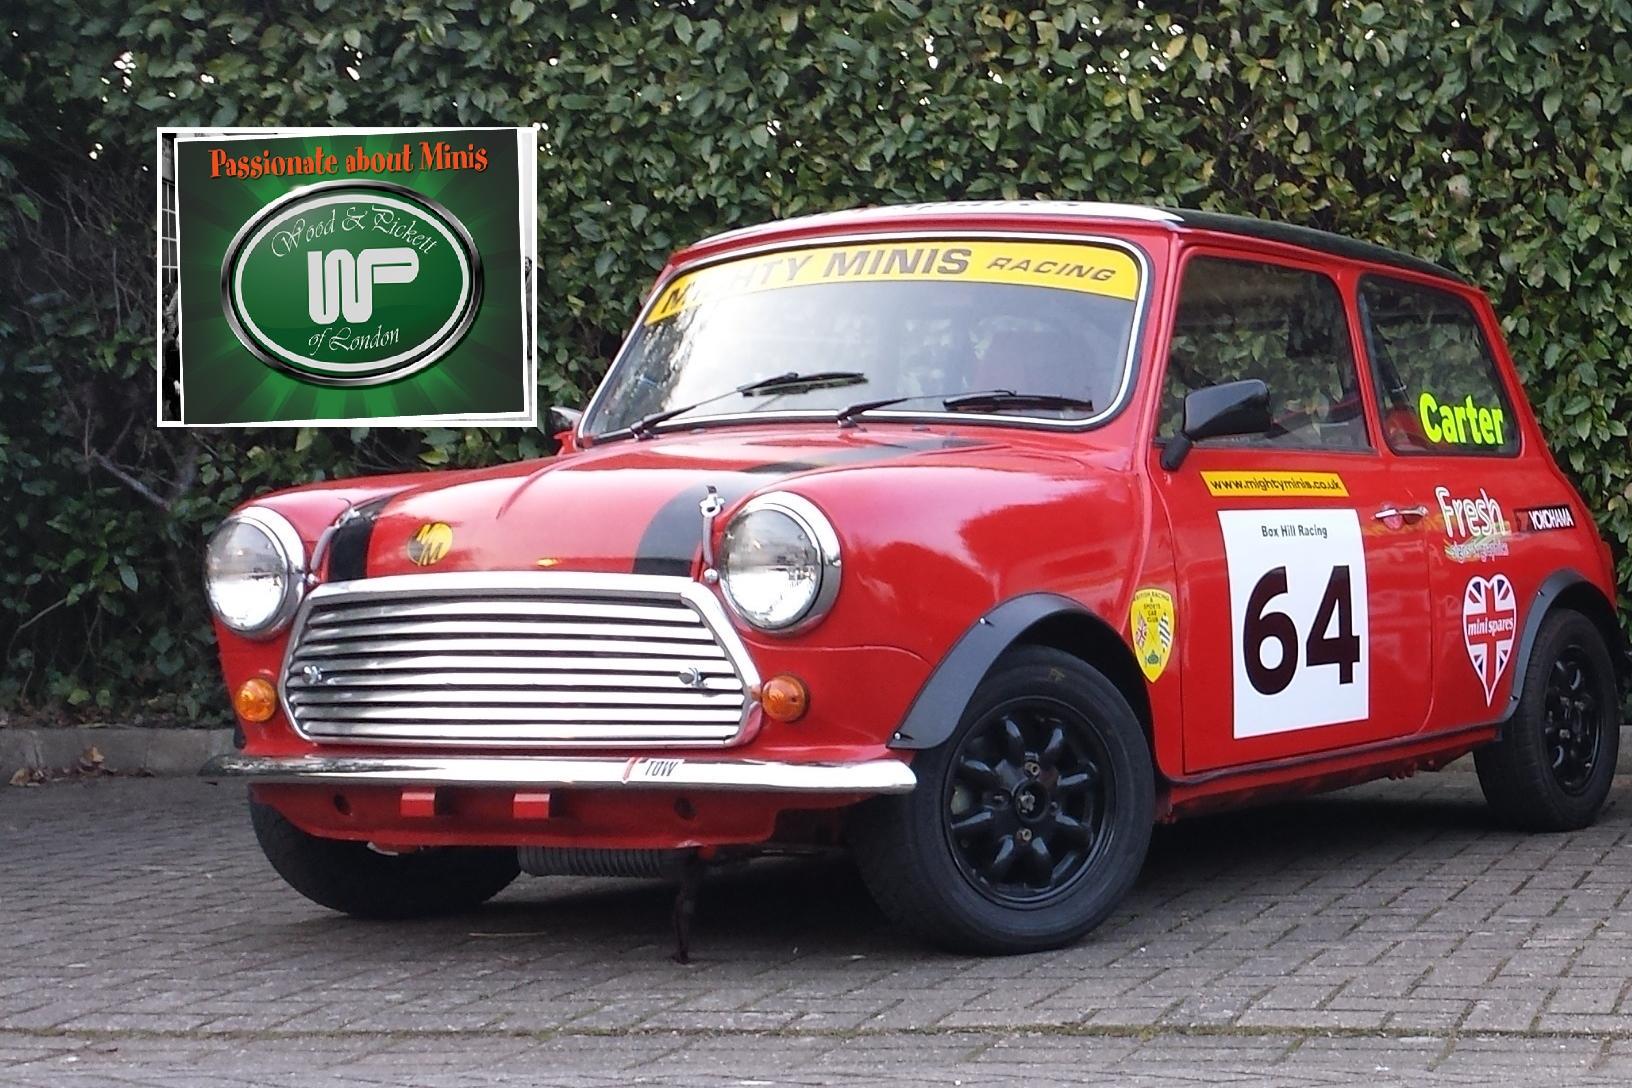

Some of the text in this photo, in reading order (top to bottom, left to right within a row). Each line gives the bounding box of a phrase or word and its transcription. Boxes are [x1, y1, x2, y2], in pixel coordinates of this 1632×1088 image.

[823, 248, 971, 278] MINIS
[985, 257, 1116, 281] RACING
[1419, 392, 1504, 445] Carter
[1211, 477, 1341, 492] www.mightyminis.co.uk
[1434, 486, 1507, 538] Fresh
[1528, 507, 1575, 531] YOKOHAMA
[1261, 525, 1328, 539] Box Hill Racing
[1243, 565, 1360, 696] 64
[645, 760, 678, 776] TOW
